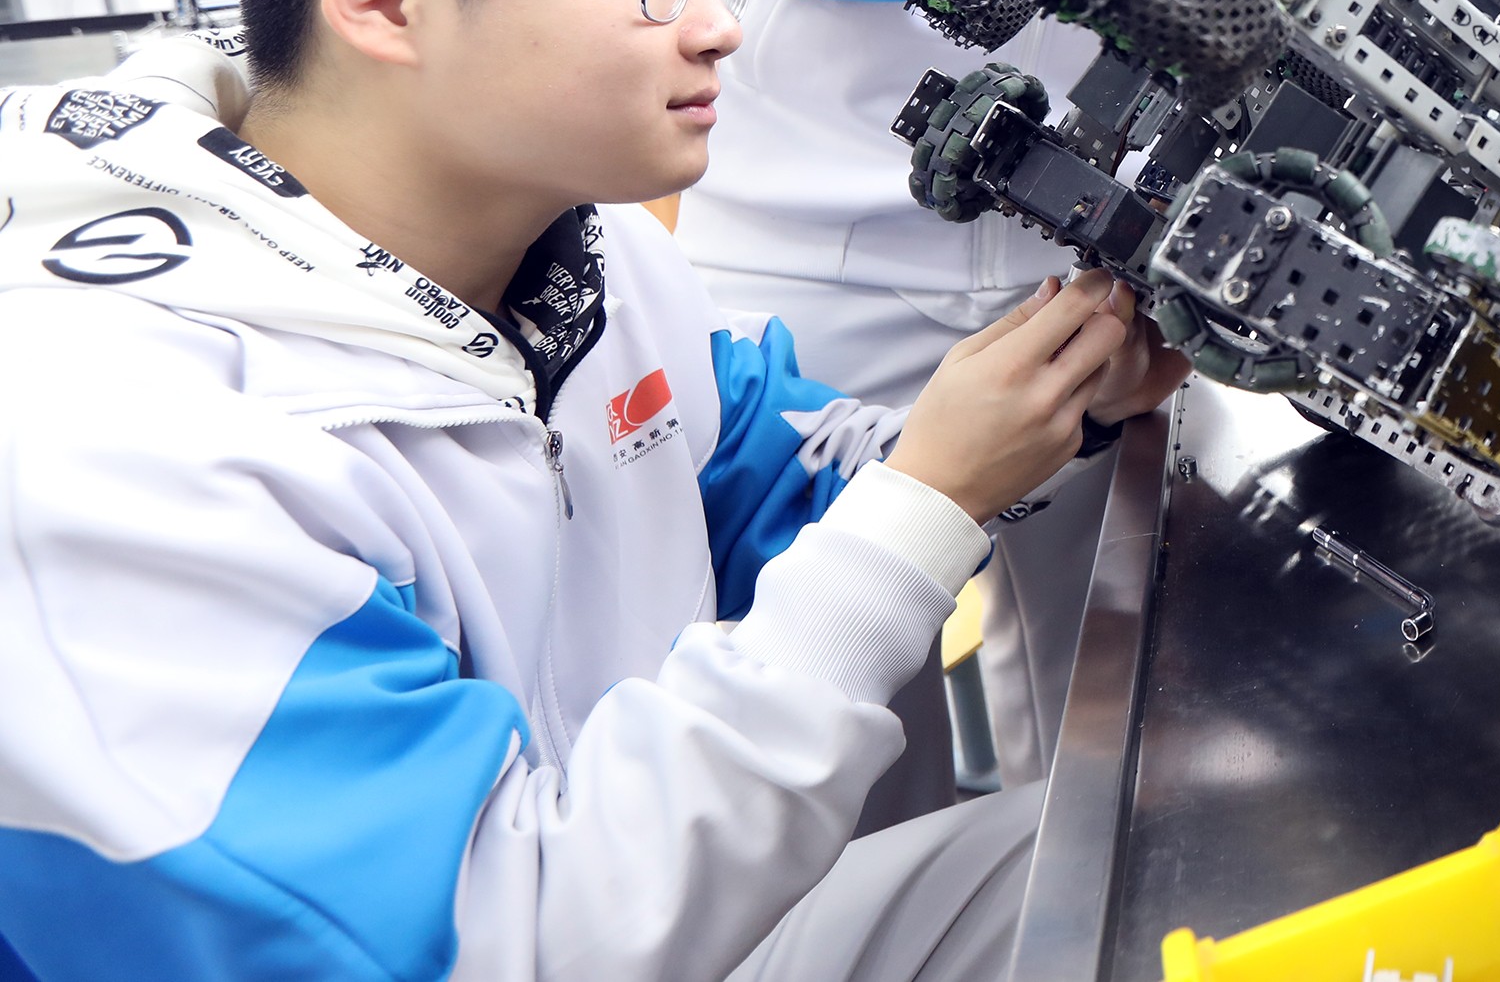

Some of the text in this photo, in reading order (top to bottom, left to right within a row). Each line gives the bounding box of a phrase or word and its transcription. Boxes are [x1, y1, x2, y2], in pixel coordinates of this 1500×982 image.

[228, 145, 285, 187] EVERY
[278, 249, 316, 273] KEEP
[546, 261, 578, 293] EVERY
[539, 283, 573, 317] BREAK
